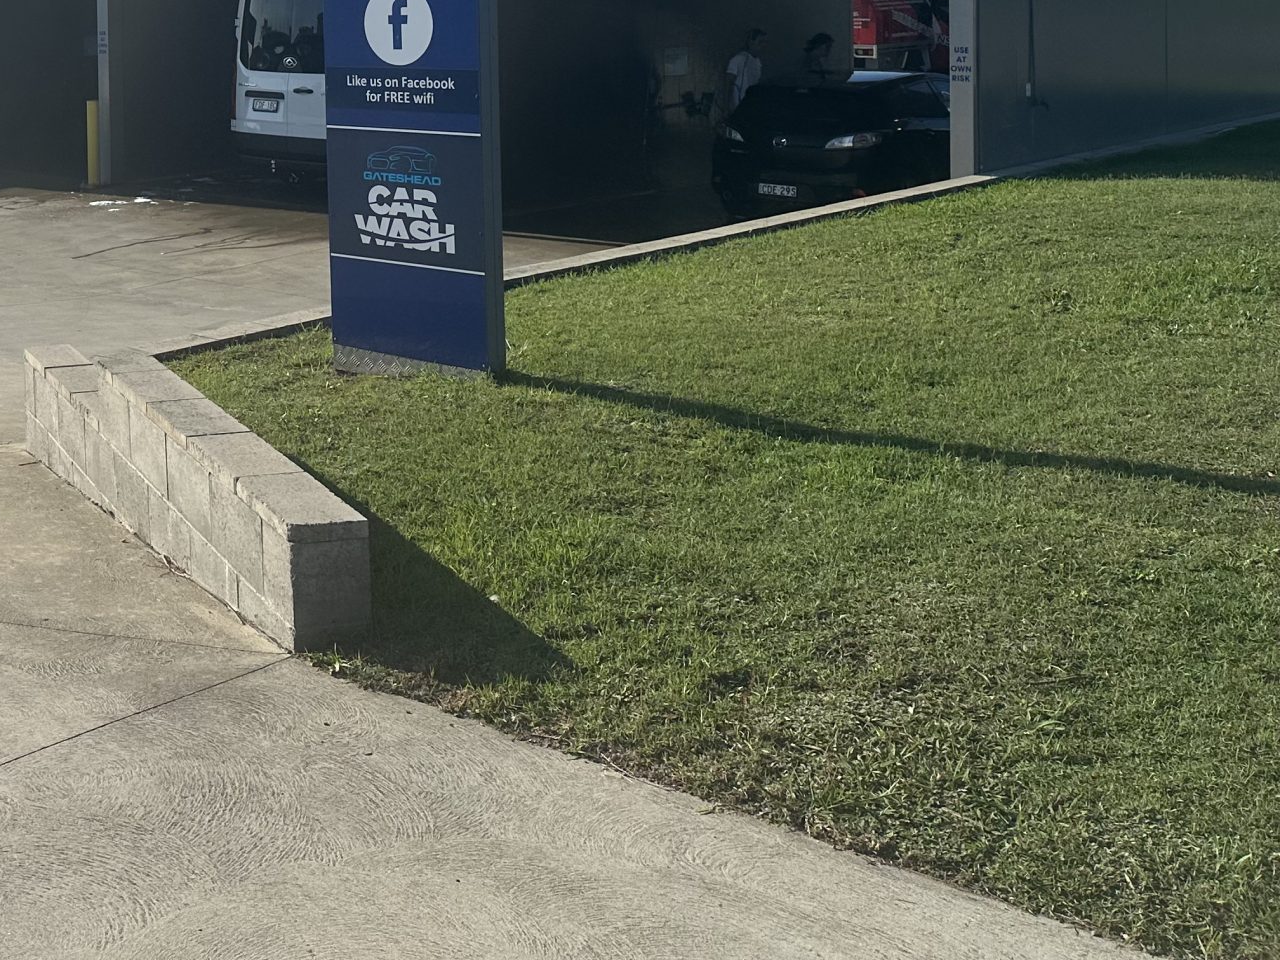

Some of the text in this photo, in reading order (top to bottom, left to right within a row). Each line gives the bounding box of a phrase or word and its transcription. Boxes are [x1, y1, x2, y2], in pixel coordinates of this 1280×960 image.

[953, 46, 969, 54] USE
[956, 55, 967, 63] AT
[346, 74, 455, 89] Like us on Facebook
[951, 74, 970, 82] RISK
[365, 90, 434, 104] for FREE wifi
[363, 171, 441, 186] GATESHEAD
[367, 184, 438, 220] CAR
[353, 213, 456, 254] WASH
